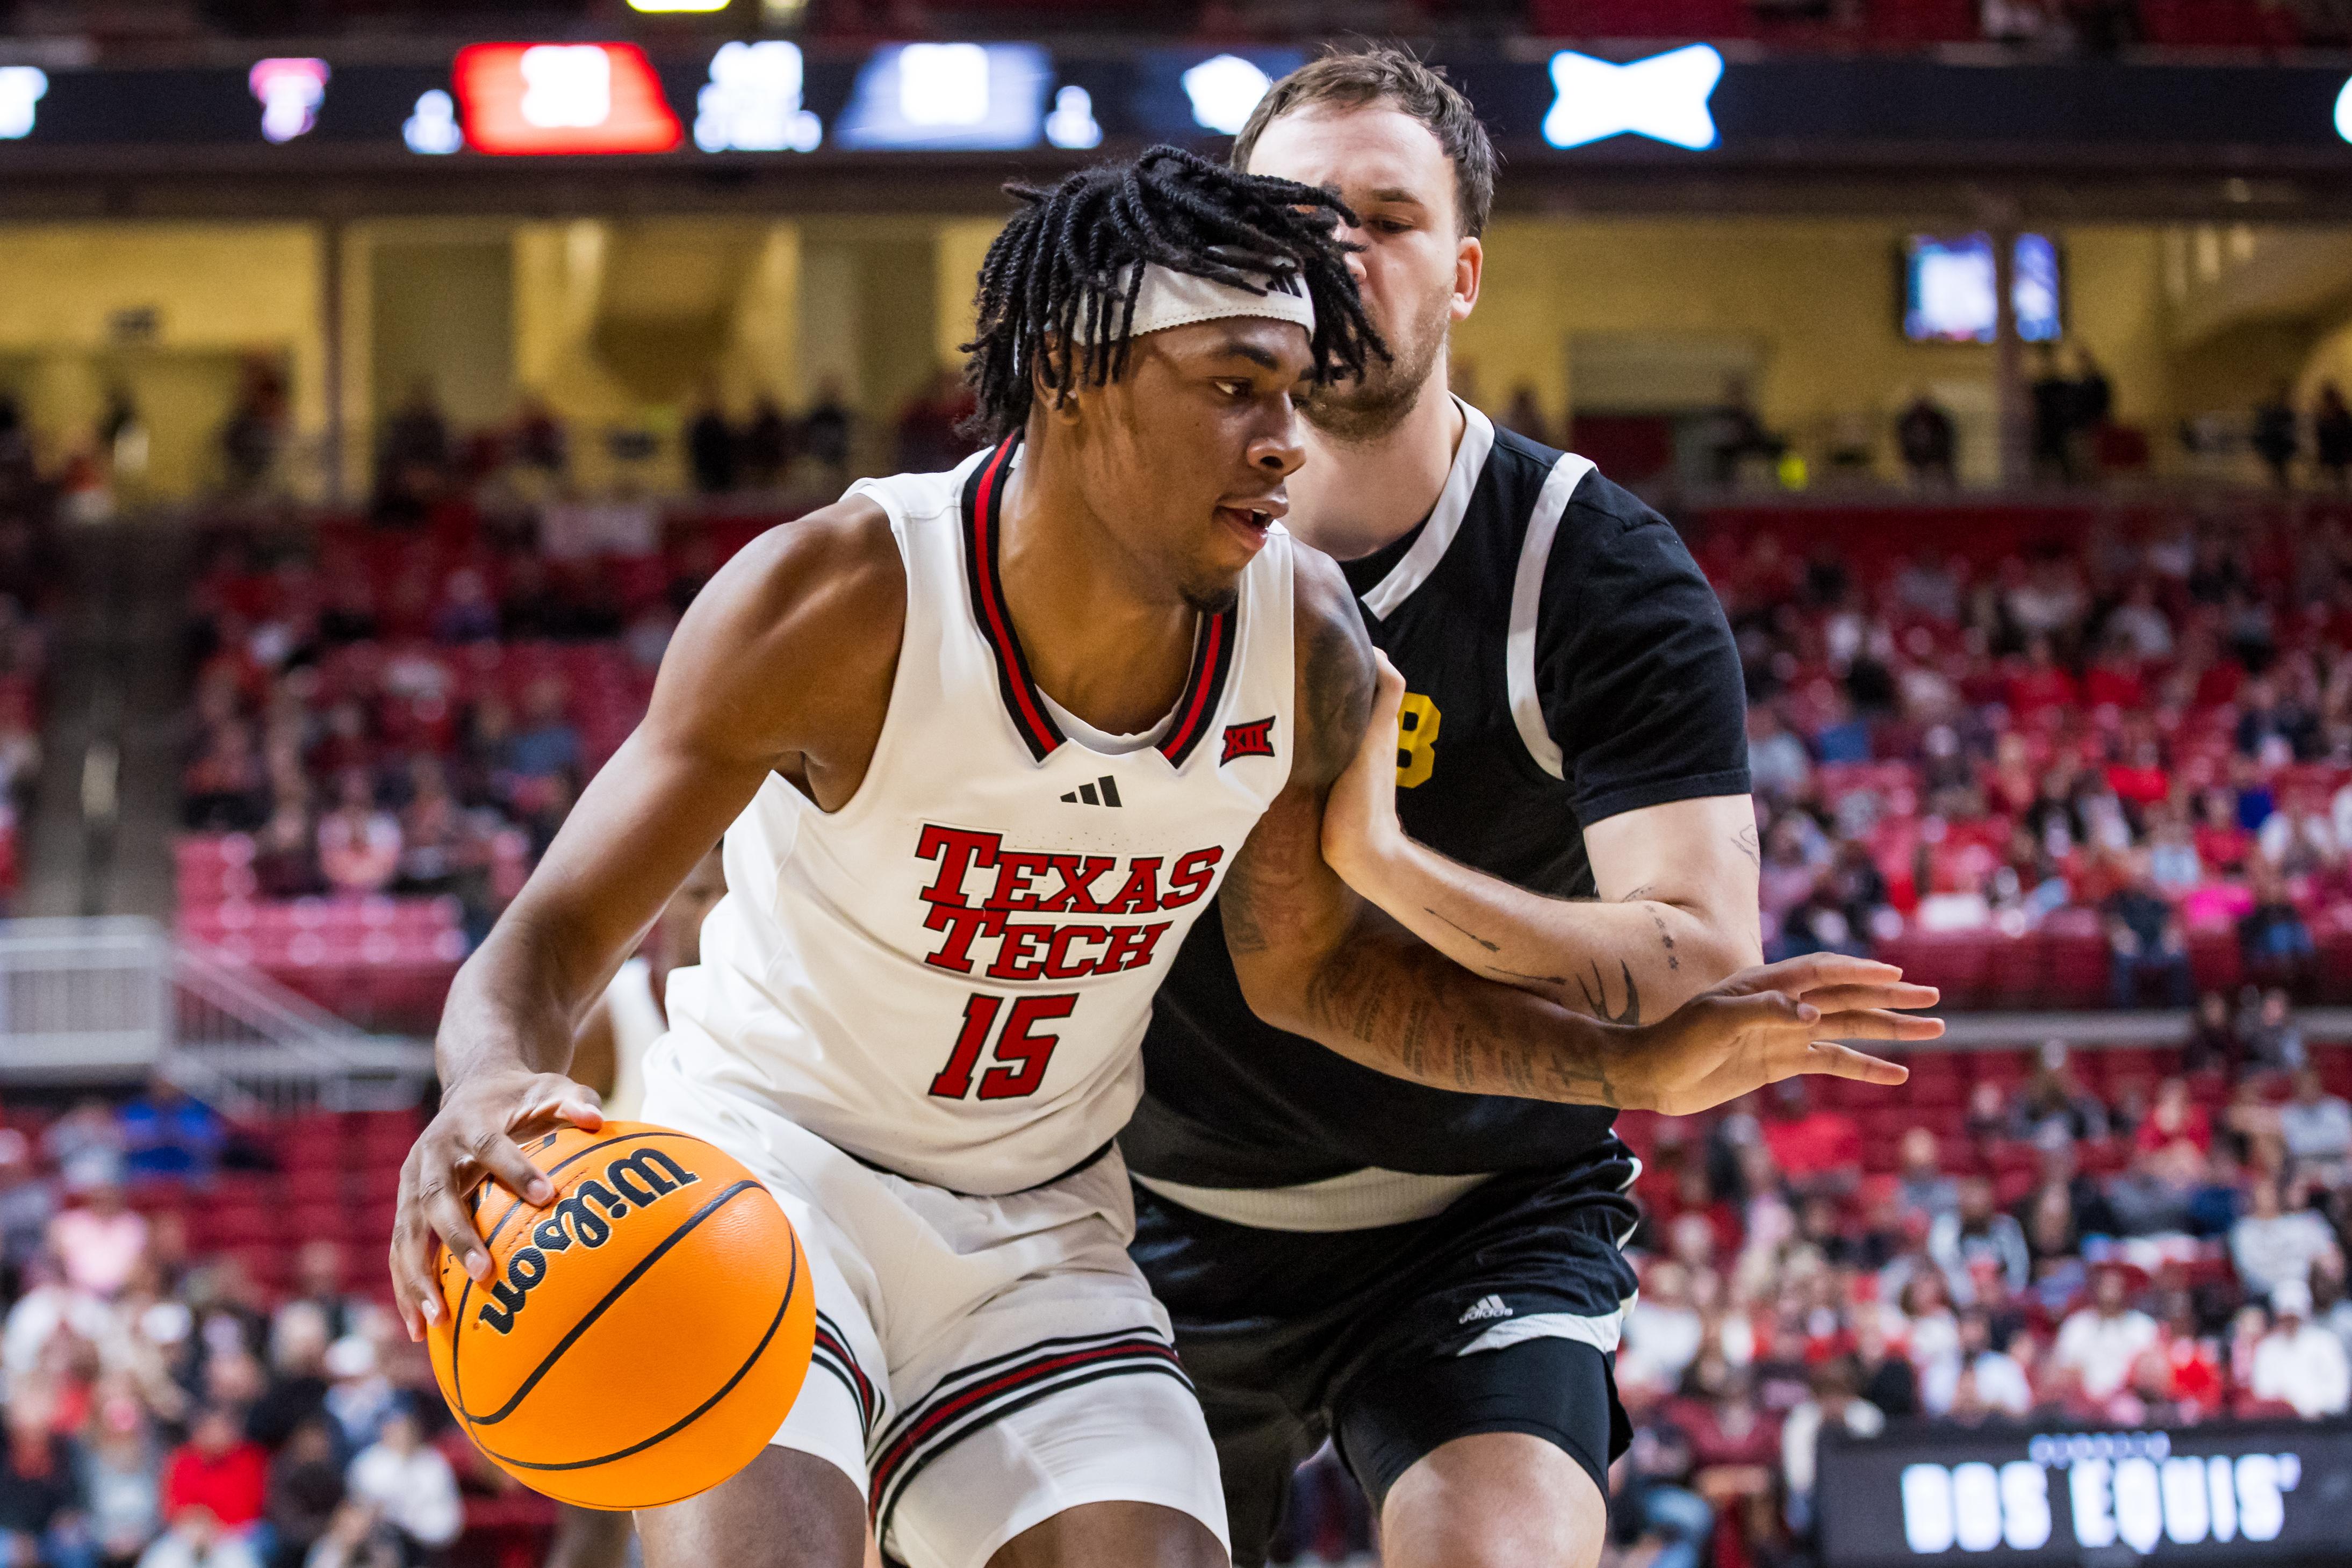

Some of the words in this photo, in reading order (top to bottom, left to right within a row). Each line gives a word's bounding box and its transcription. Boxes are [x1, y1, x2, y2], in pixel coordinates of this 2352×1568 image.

[1219, 715, 1276, 768] XII
[915, 823, 1224, 914] TEXAS
[923, 902, 1174, 981] TECH
[928, 992, 1080, 1101] 15
[478, 1148, 702, 1335] Wilson
[1459, 1306, 1513, 1324] adidas
